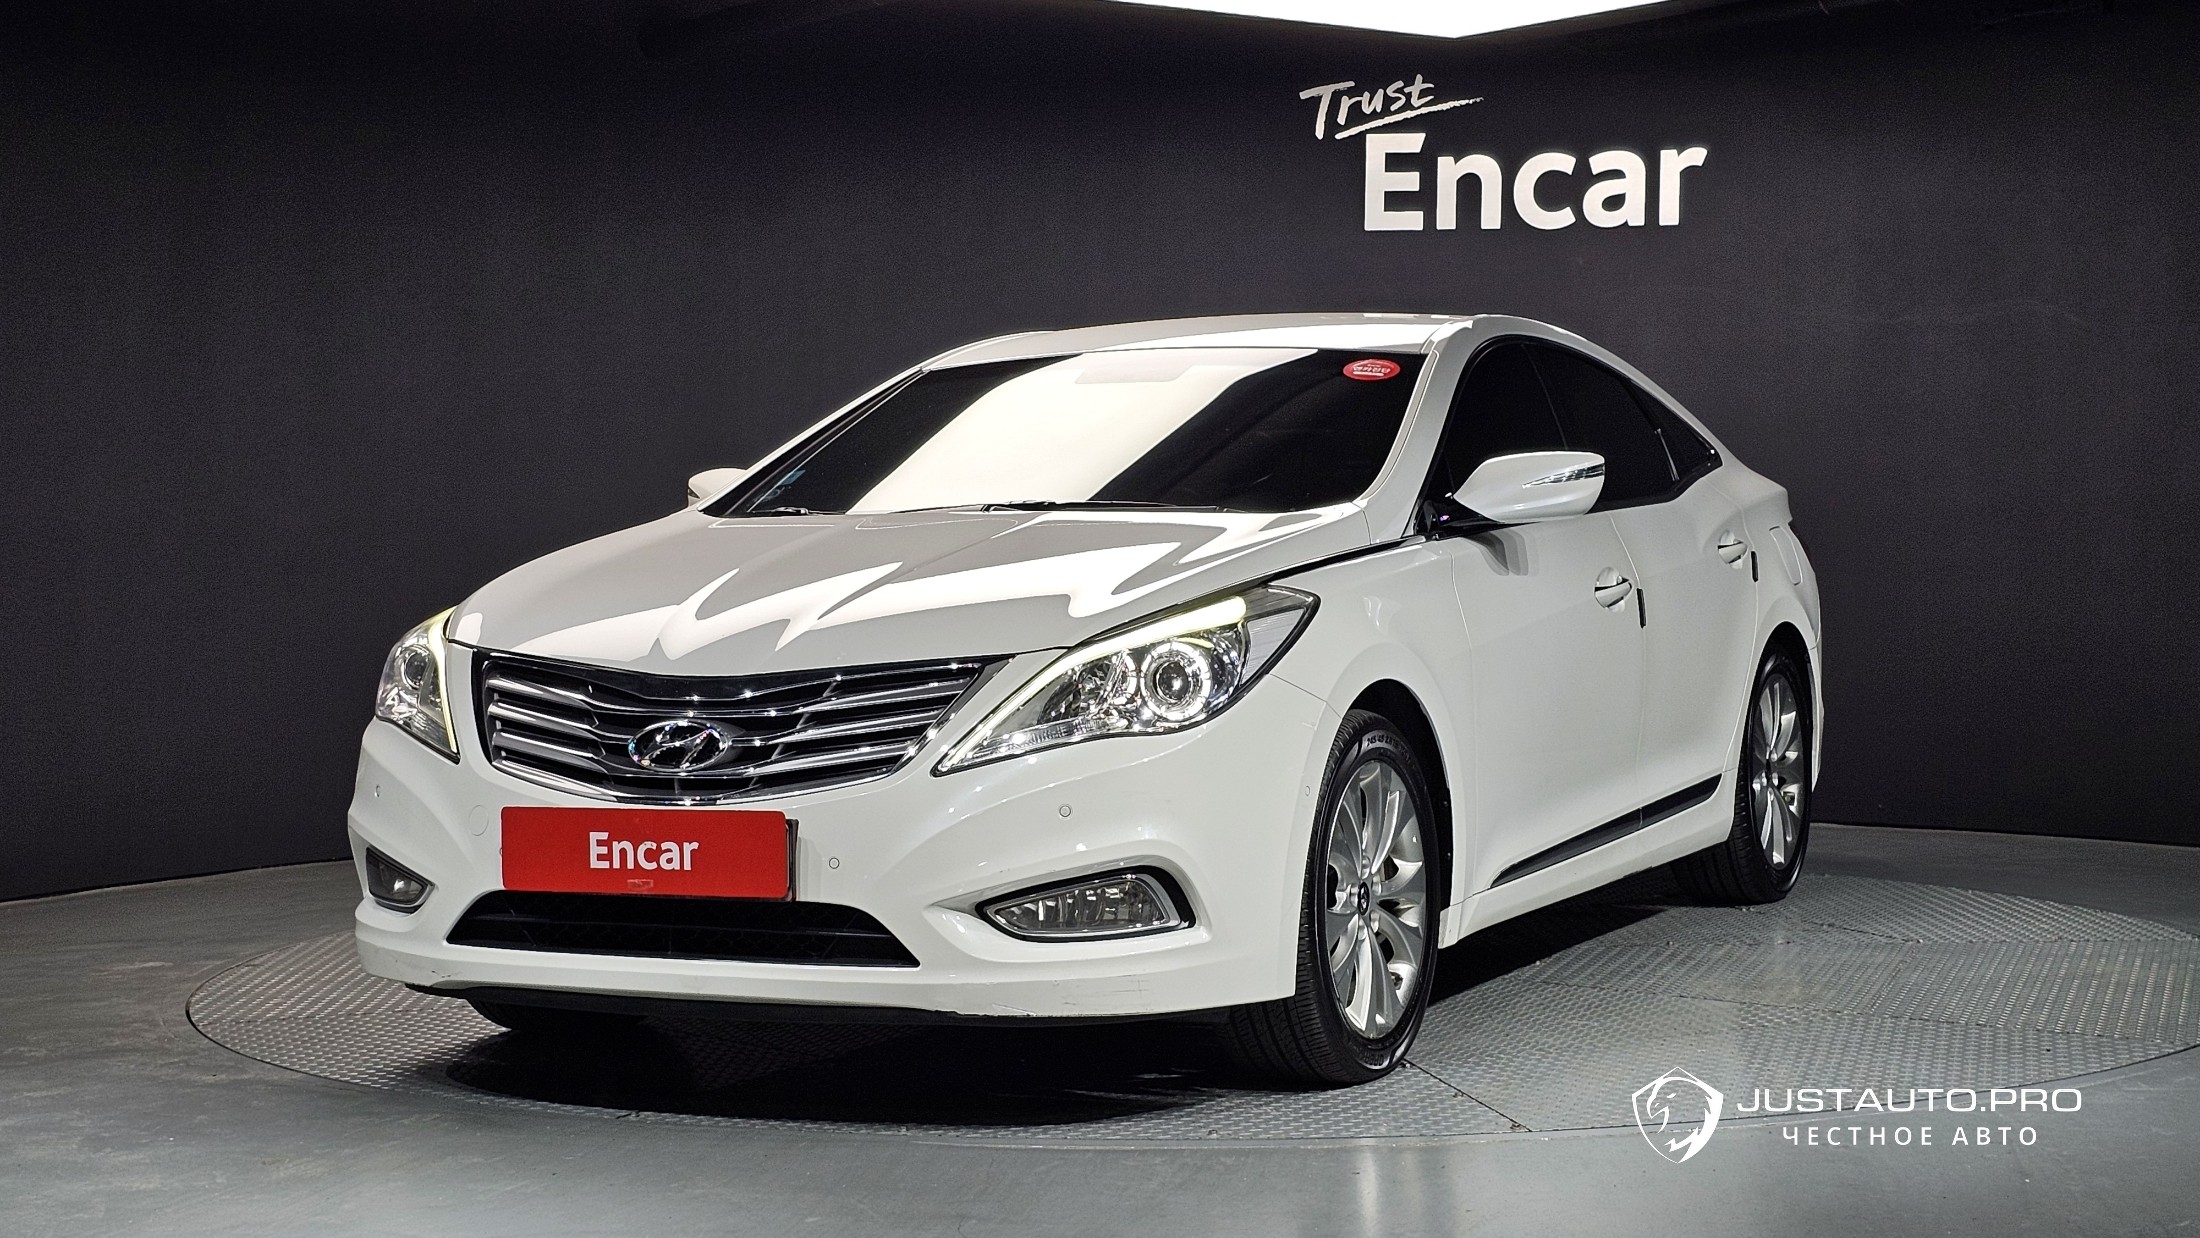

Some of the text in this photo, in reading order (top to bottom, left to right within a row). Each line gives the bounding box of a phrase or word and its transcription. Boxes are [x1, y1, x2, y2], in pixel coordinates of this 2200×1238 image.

[1299, 74, 1435, 140] Trust
[1364, 132, 1708, 231] Encar
[589, 831, 700, 871] Encar
